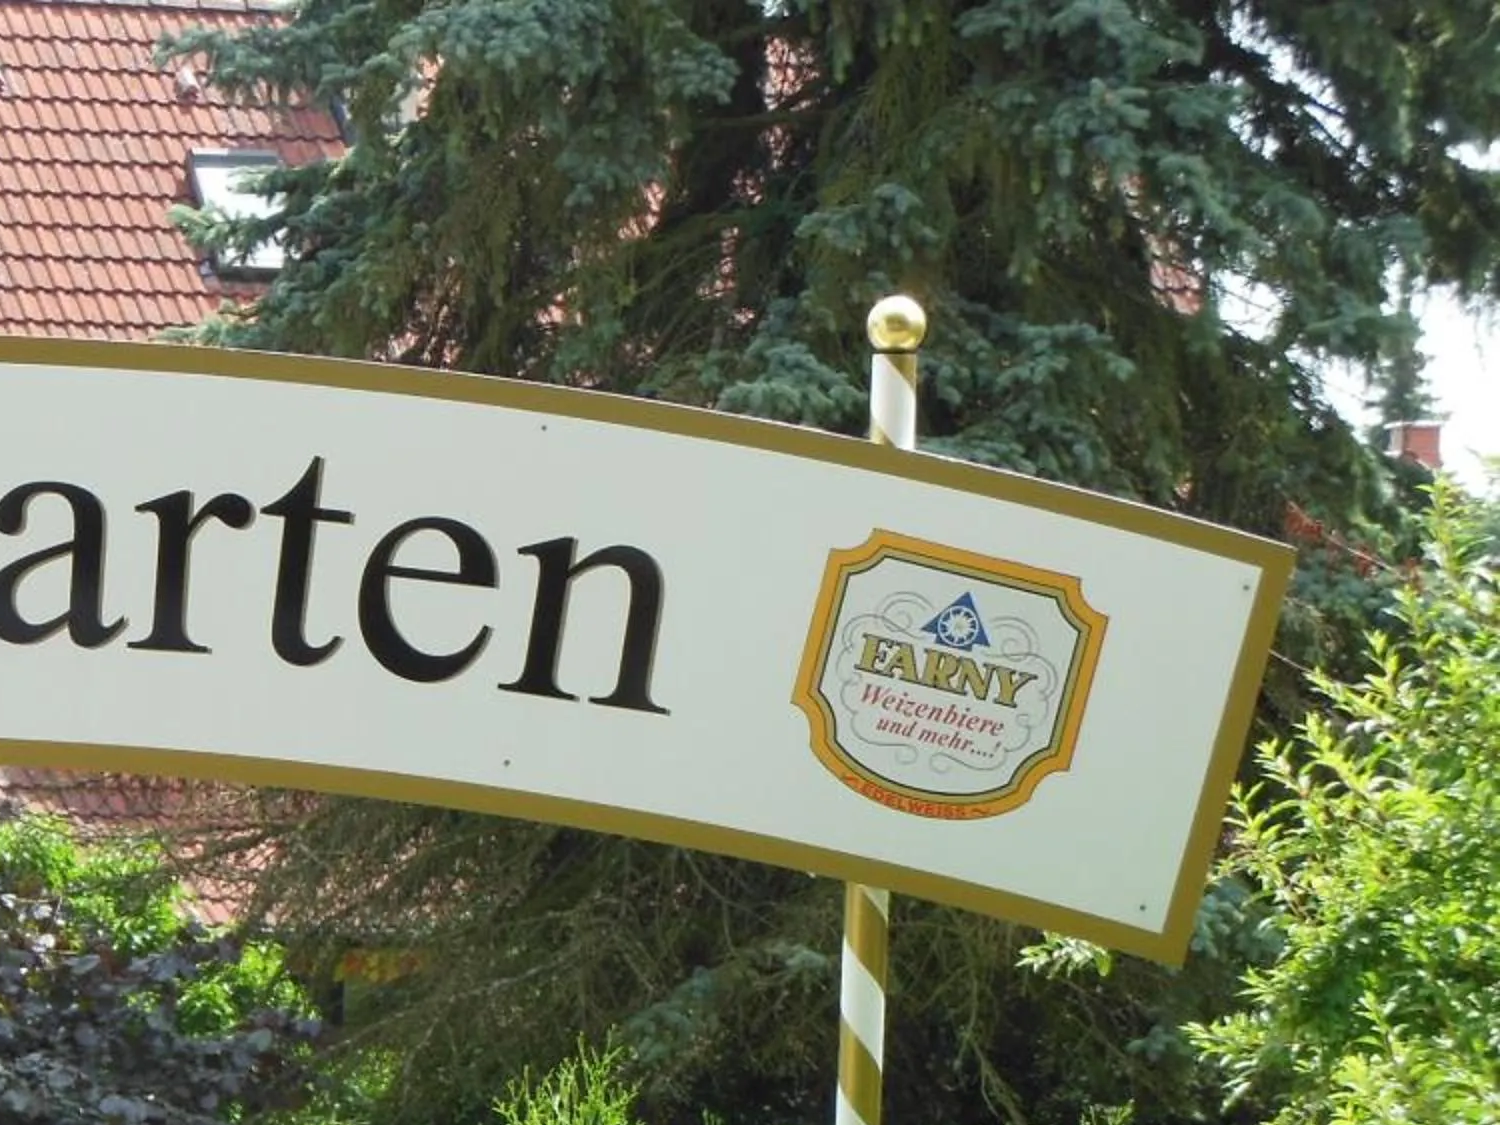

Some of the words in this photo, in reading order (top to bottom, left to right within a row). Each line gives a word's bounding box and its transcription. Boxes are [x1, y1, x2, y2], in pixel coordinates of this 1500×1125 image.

[854, 633, 1037, 708] FARNY
[860, 683, 1005, 737] Weizenbiere
[875, 717, 918, 737] und
